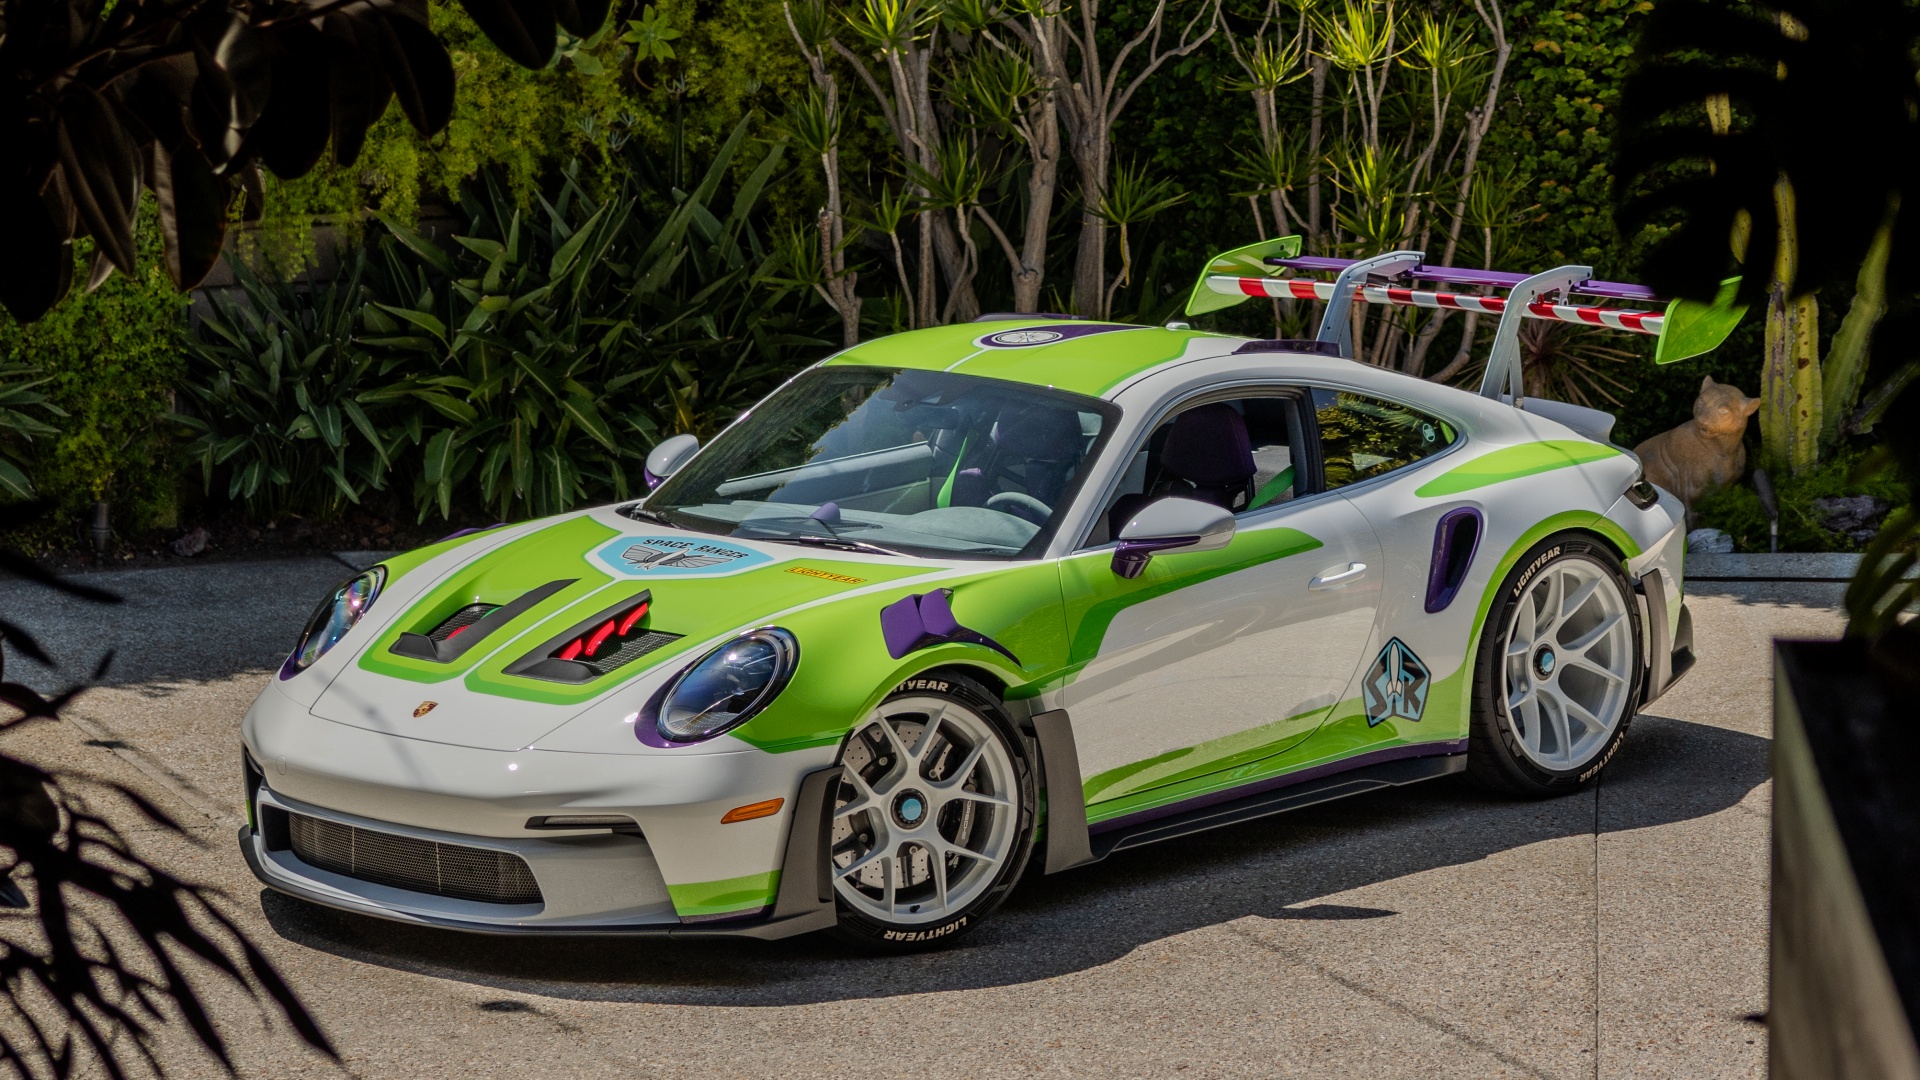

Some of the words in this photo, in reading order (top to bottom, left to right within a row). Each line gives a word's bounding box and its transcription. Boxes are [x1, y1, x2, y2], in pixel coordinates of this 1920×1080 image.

[643, 539, 695, 549] SPACE
[694, 544, 749, 559] RANGER
[1513, 546, 1561, 597] LIGHTYEAR
[893, 679, 949, 693] TYEAR
[1580, 731, 1624, 783] LIGHTYEAR
[883, 916, 967, 942] LIGHTYEAR
